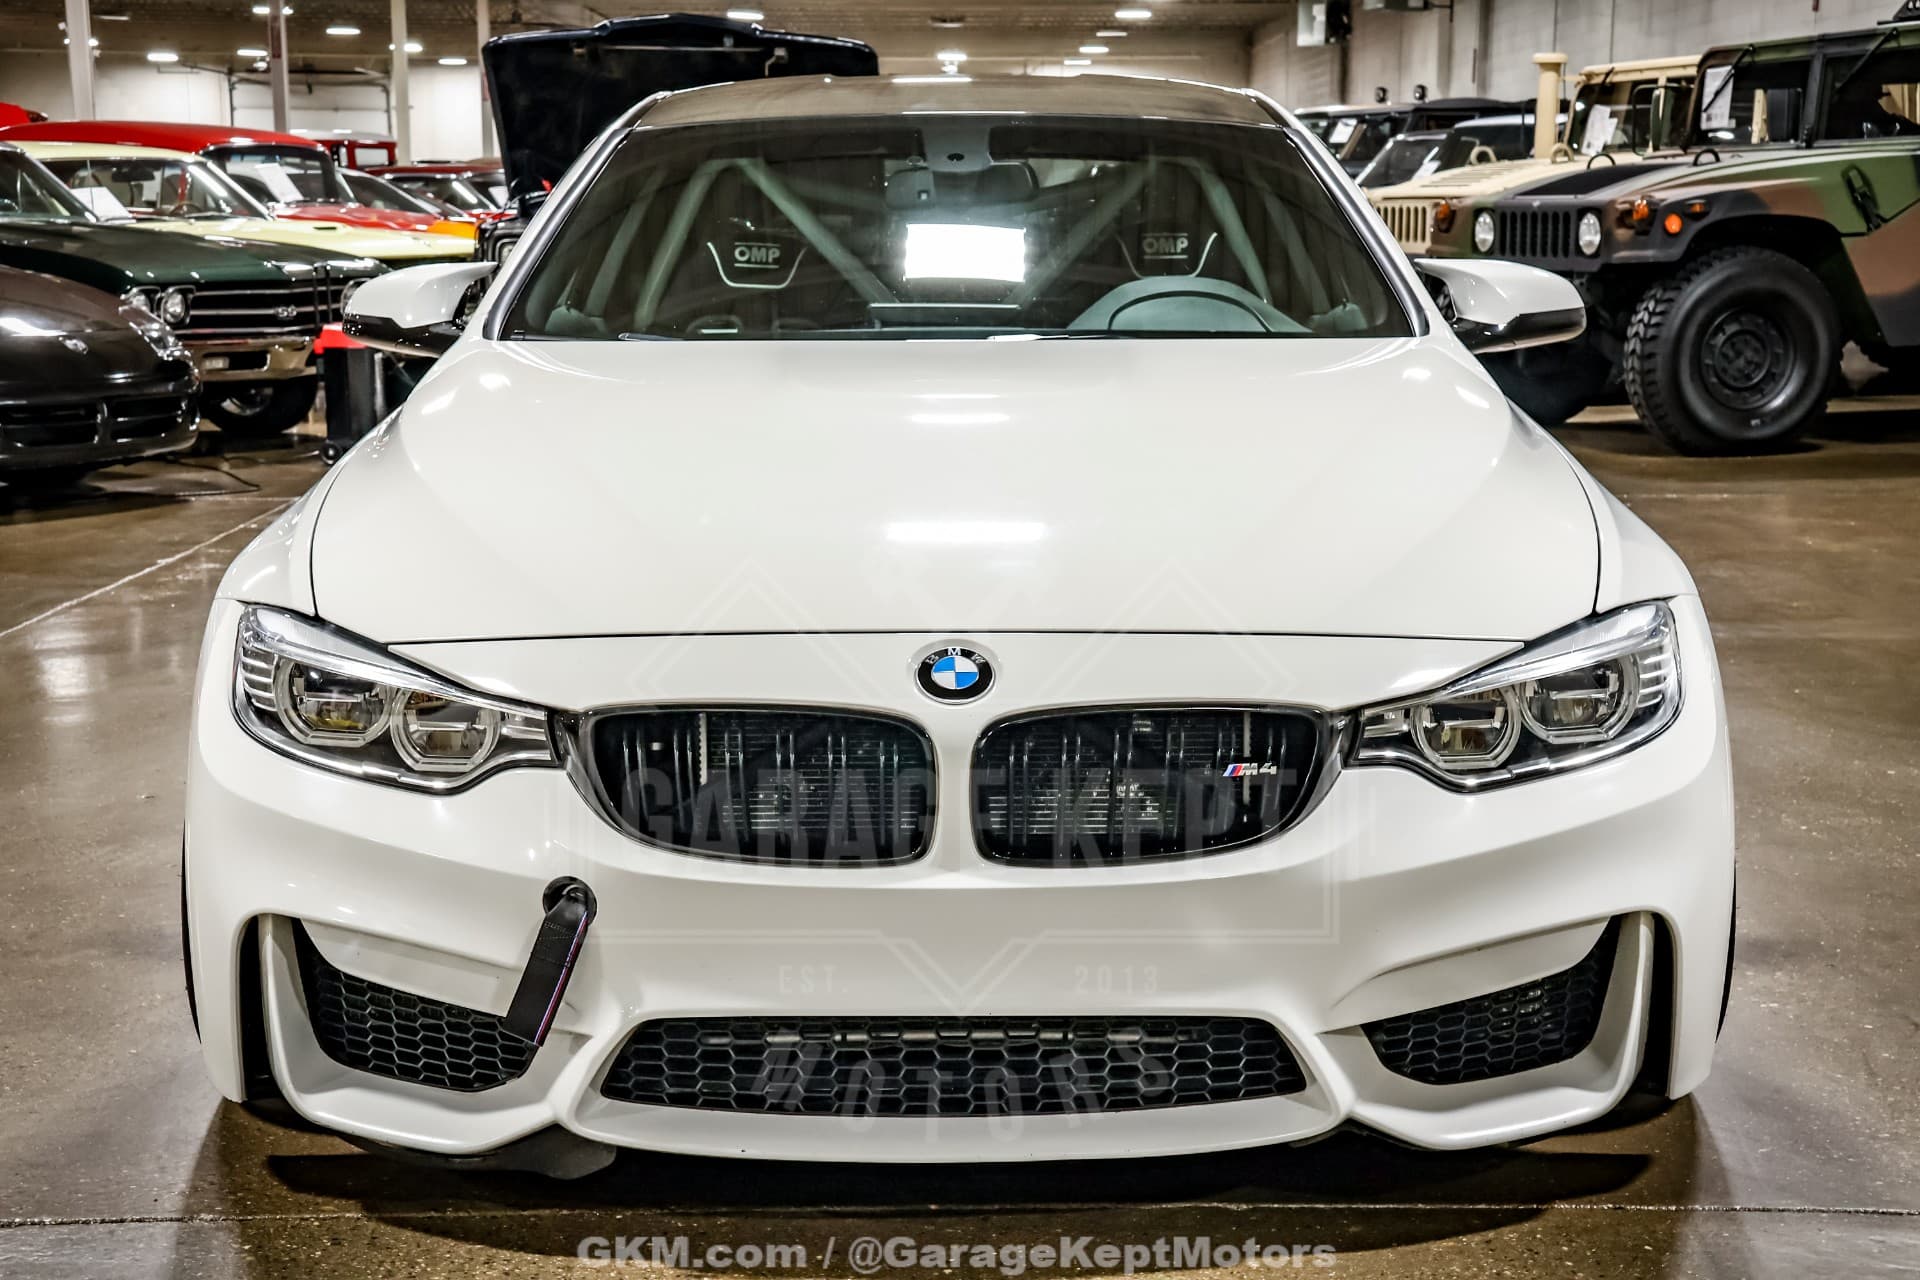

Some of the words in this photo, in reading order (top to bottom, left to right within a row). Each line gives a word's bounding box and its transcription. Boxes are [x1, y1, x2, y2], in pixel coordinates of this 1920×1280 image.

[1142, 237, 1189, 254] OMP
[734, 246, 780, 263] OMP
[924, 647, 986, 664] BMW
[1234, 763, 1277, 776] M4
